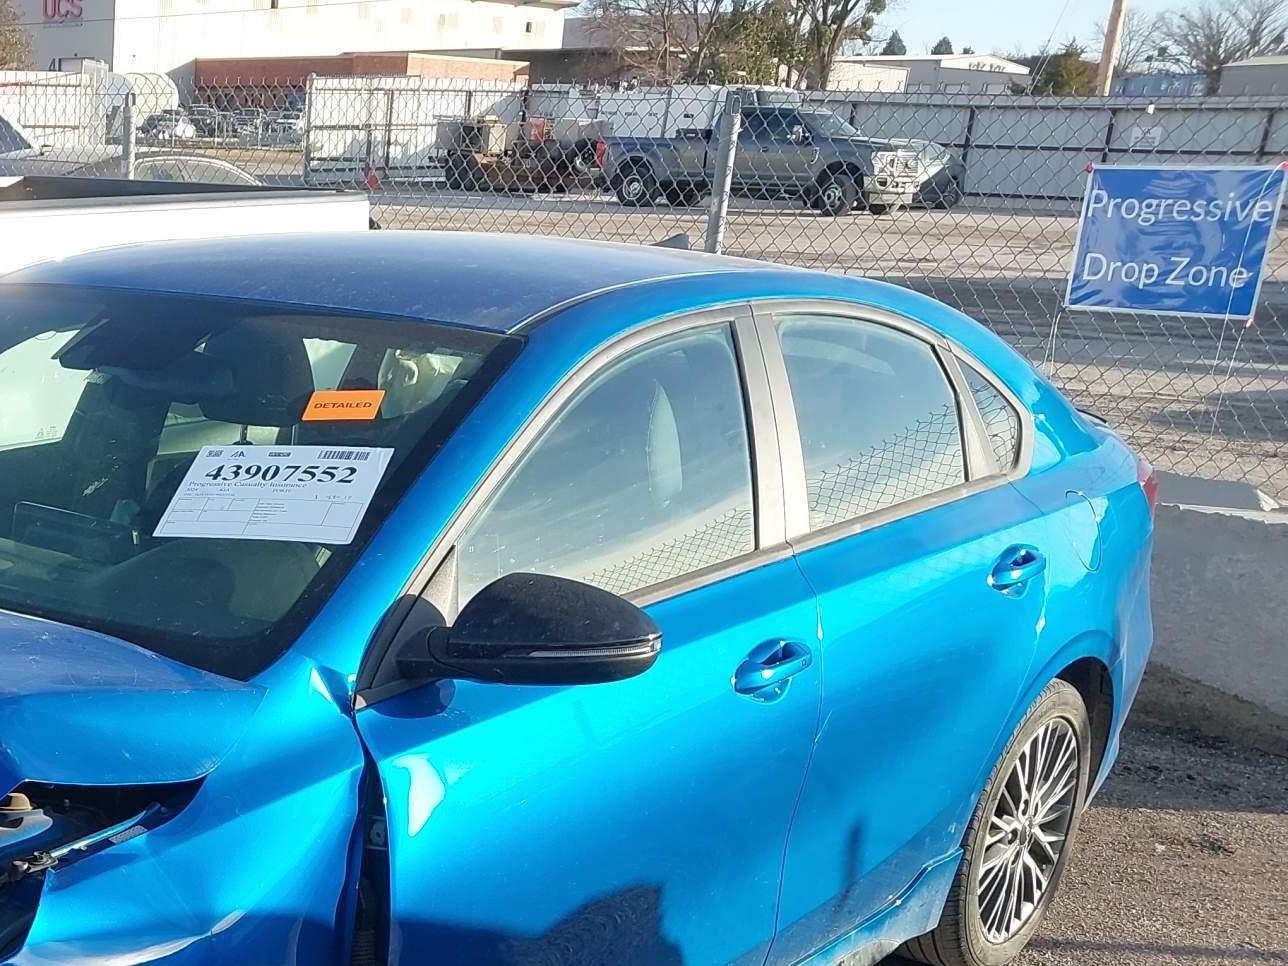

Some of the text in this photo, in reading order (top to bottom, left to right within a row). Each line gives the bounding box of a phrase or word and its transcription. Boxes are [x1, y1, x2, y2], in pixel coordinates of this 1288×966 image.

[1087, 190, 1273, 226] Progressive
[1083, 253, 1253, 288] Drop Zone
[188, 480, 307, 489] Progressive Casualty Insurance
[205, 464, 357, 483] 43907552
